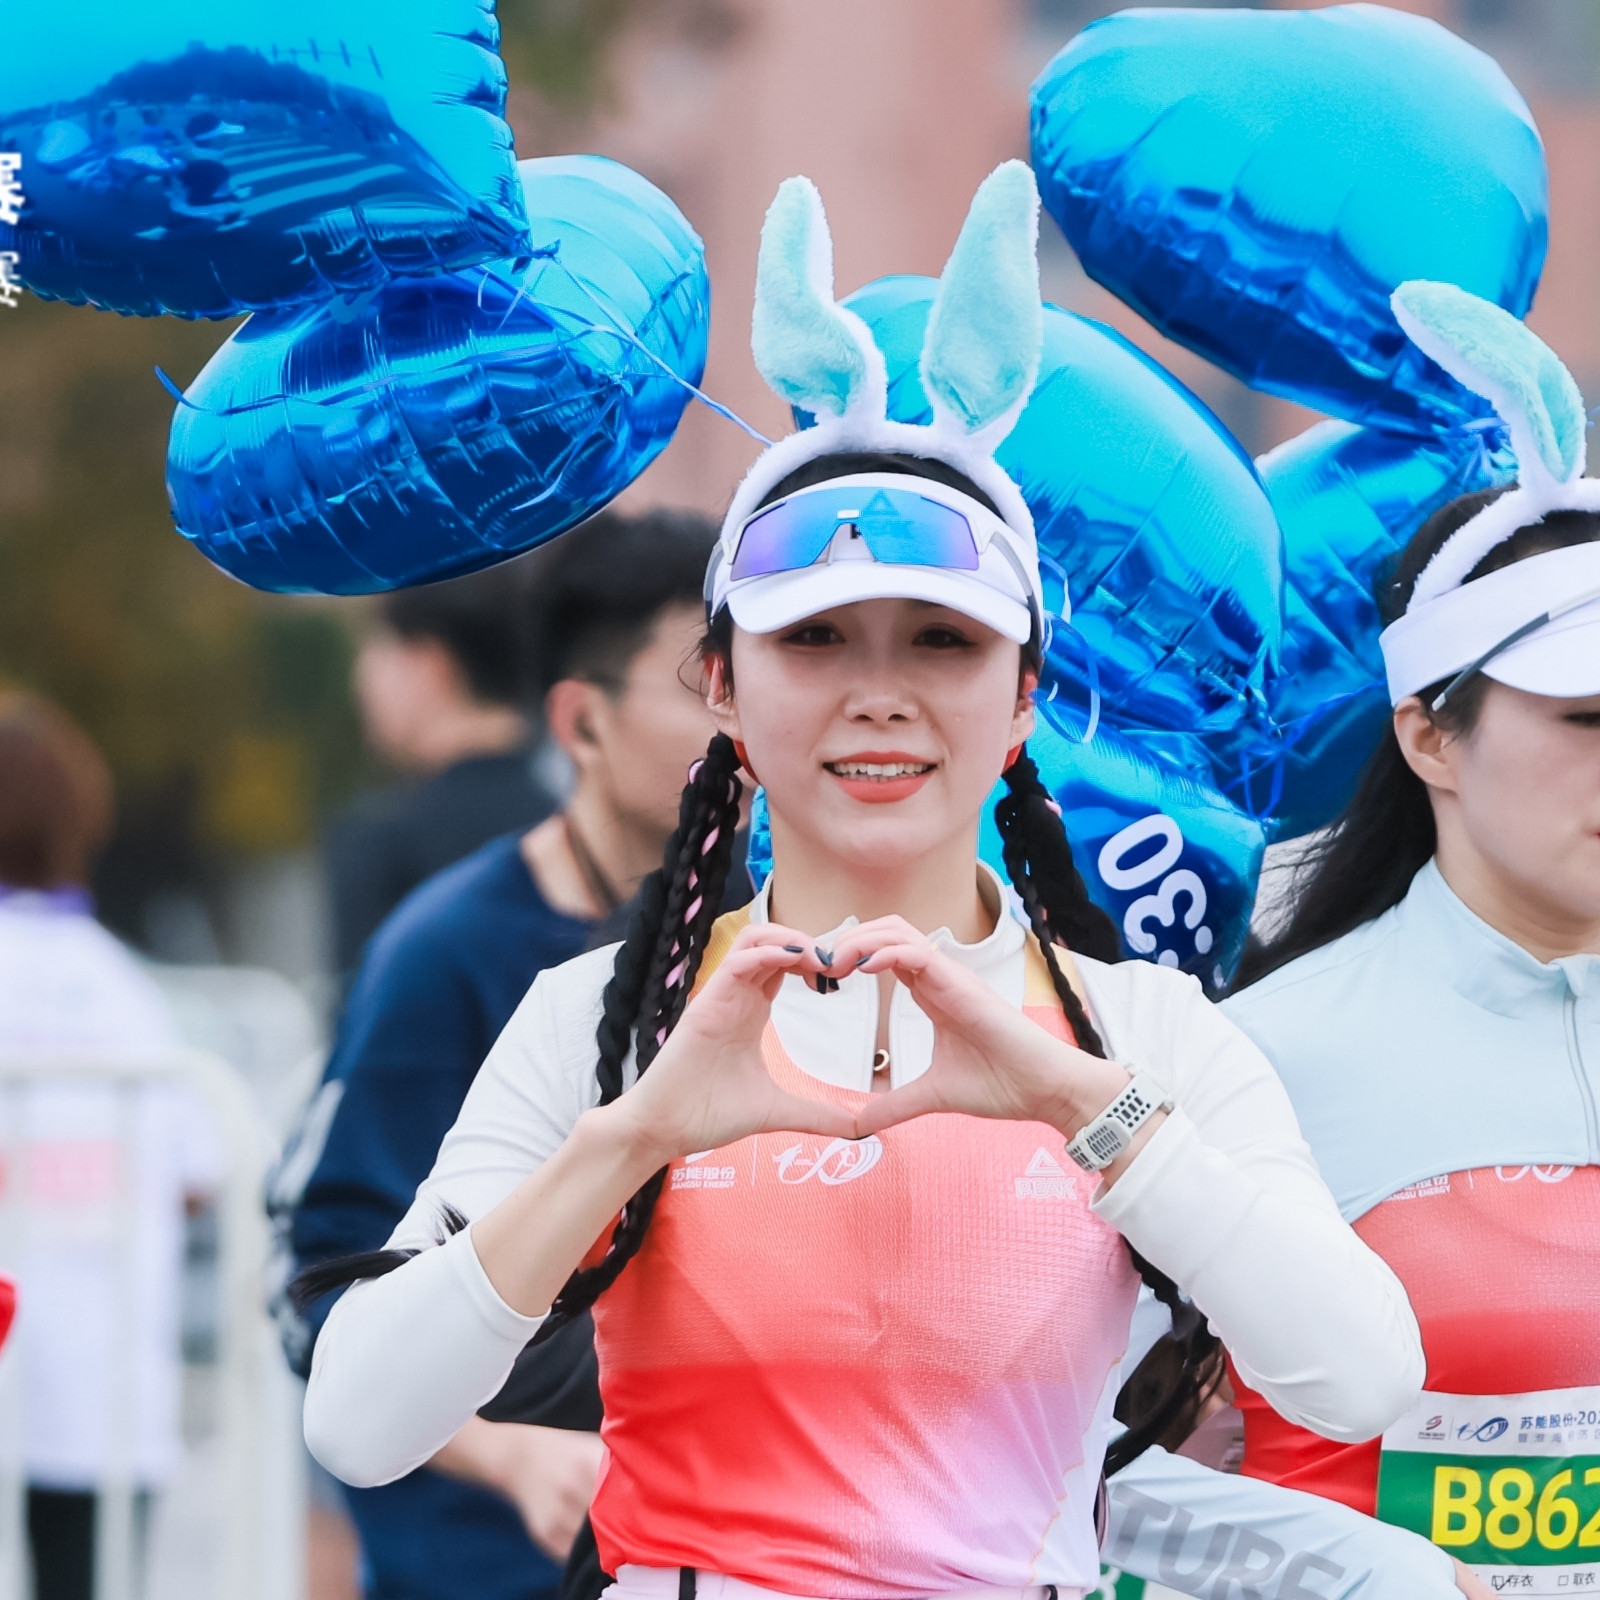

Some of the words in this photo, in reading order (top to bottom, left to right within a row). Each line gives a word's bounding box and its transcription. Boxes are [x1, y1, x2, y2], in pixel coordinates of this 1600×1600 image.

[671, 1166, 736, 1181] 苏能股份
[1015, 1176, 1077, 1199] PEAK
[1572, 1571, 1596, 1586] 取衣
